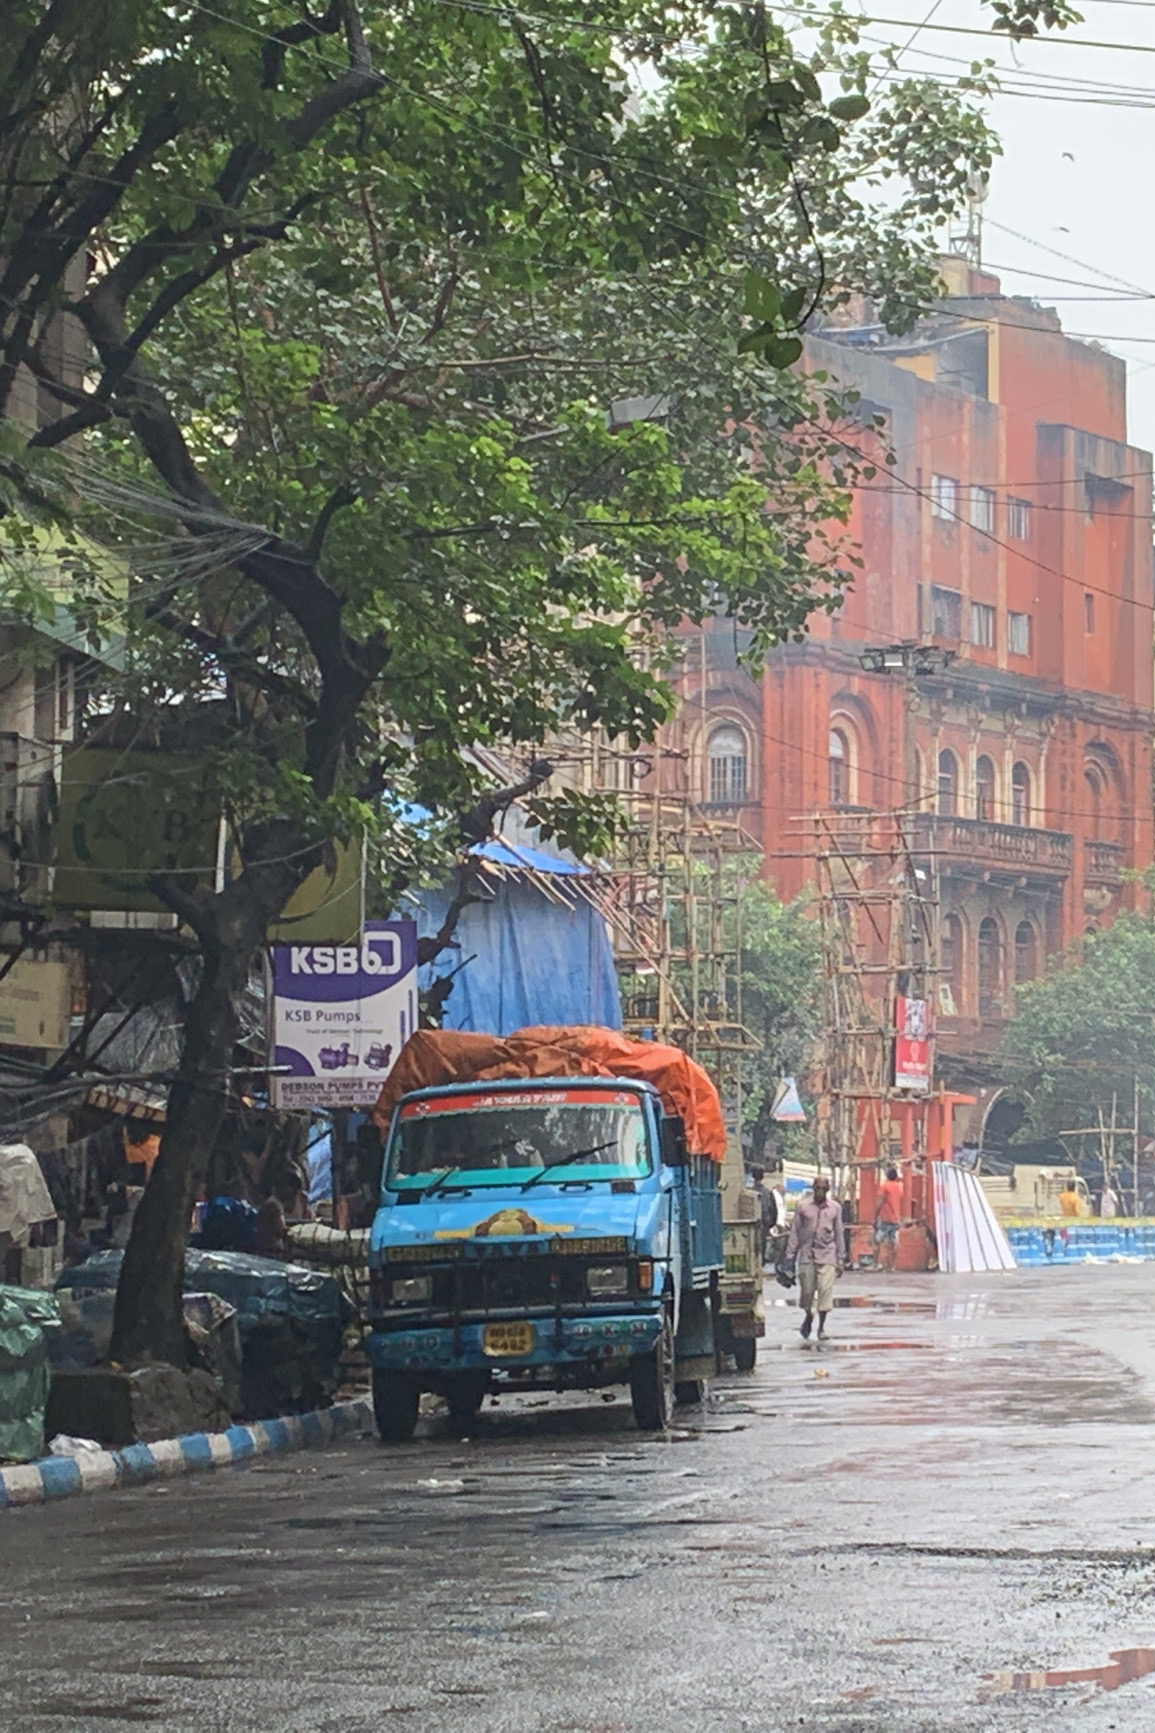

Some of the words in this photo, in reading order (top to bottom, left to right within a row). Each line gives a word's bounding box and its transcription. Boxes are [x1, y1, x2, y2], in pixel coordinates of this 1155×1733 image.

[290, 947, 359, 975] KSB
[285, 1009, 312, 1022] KSB
[315, 1009, 361, 1024] Pumps
[328, 1081, 363, 1092] PUMPS
